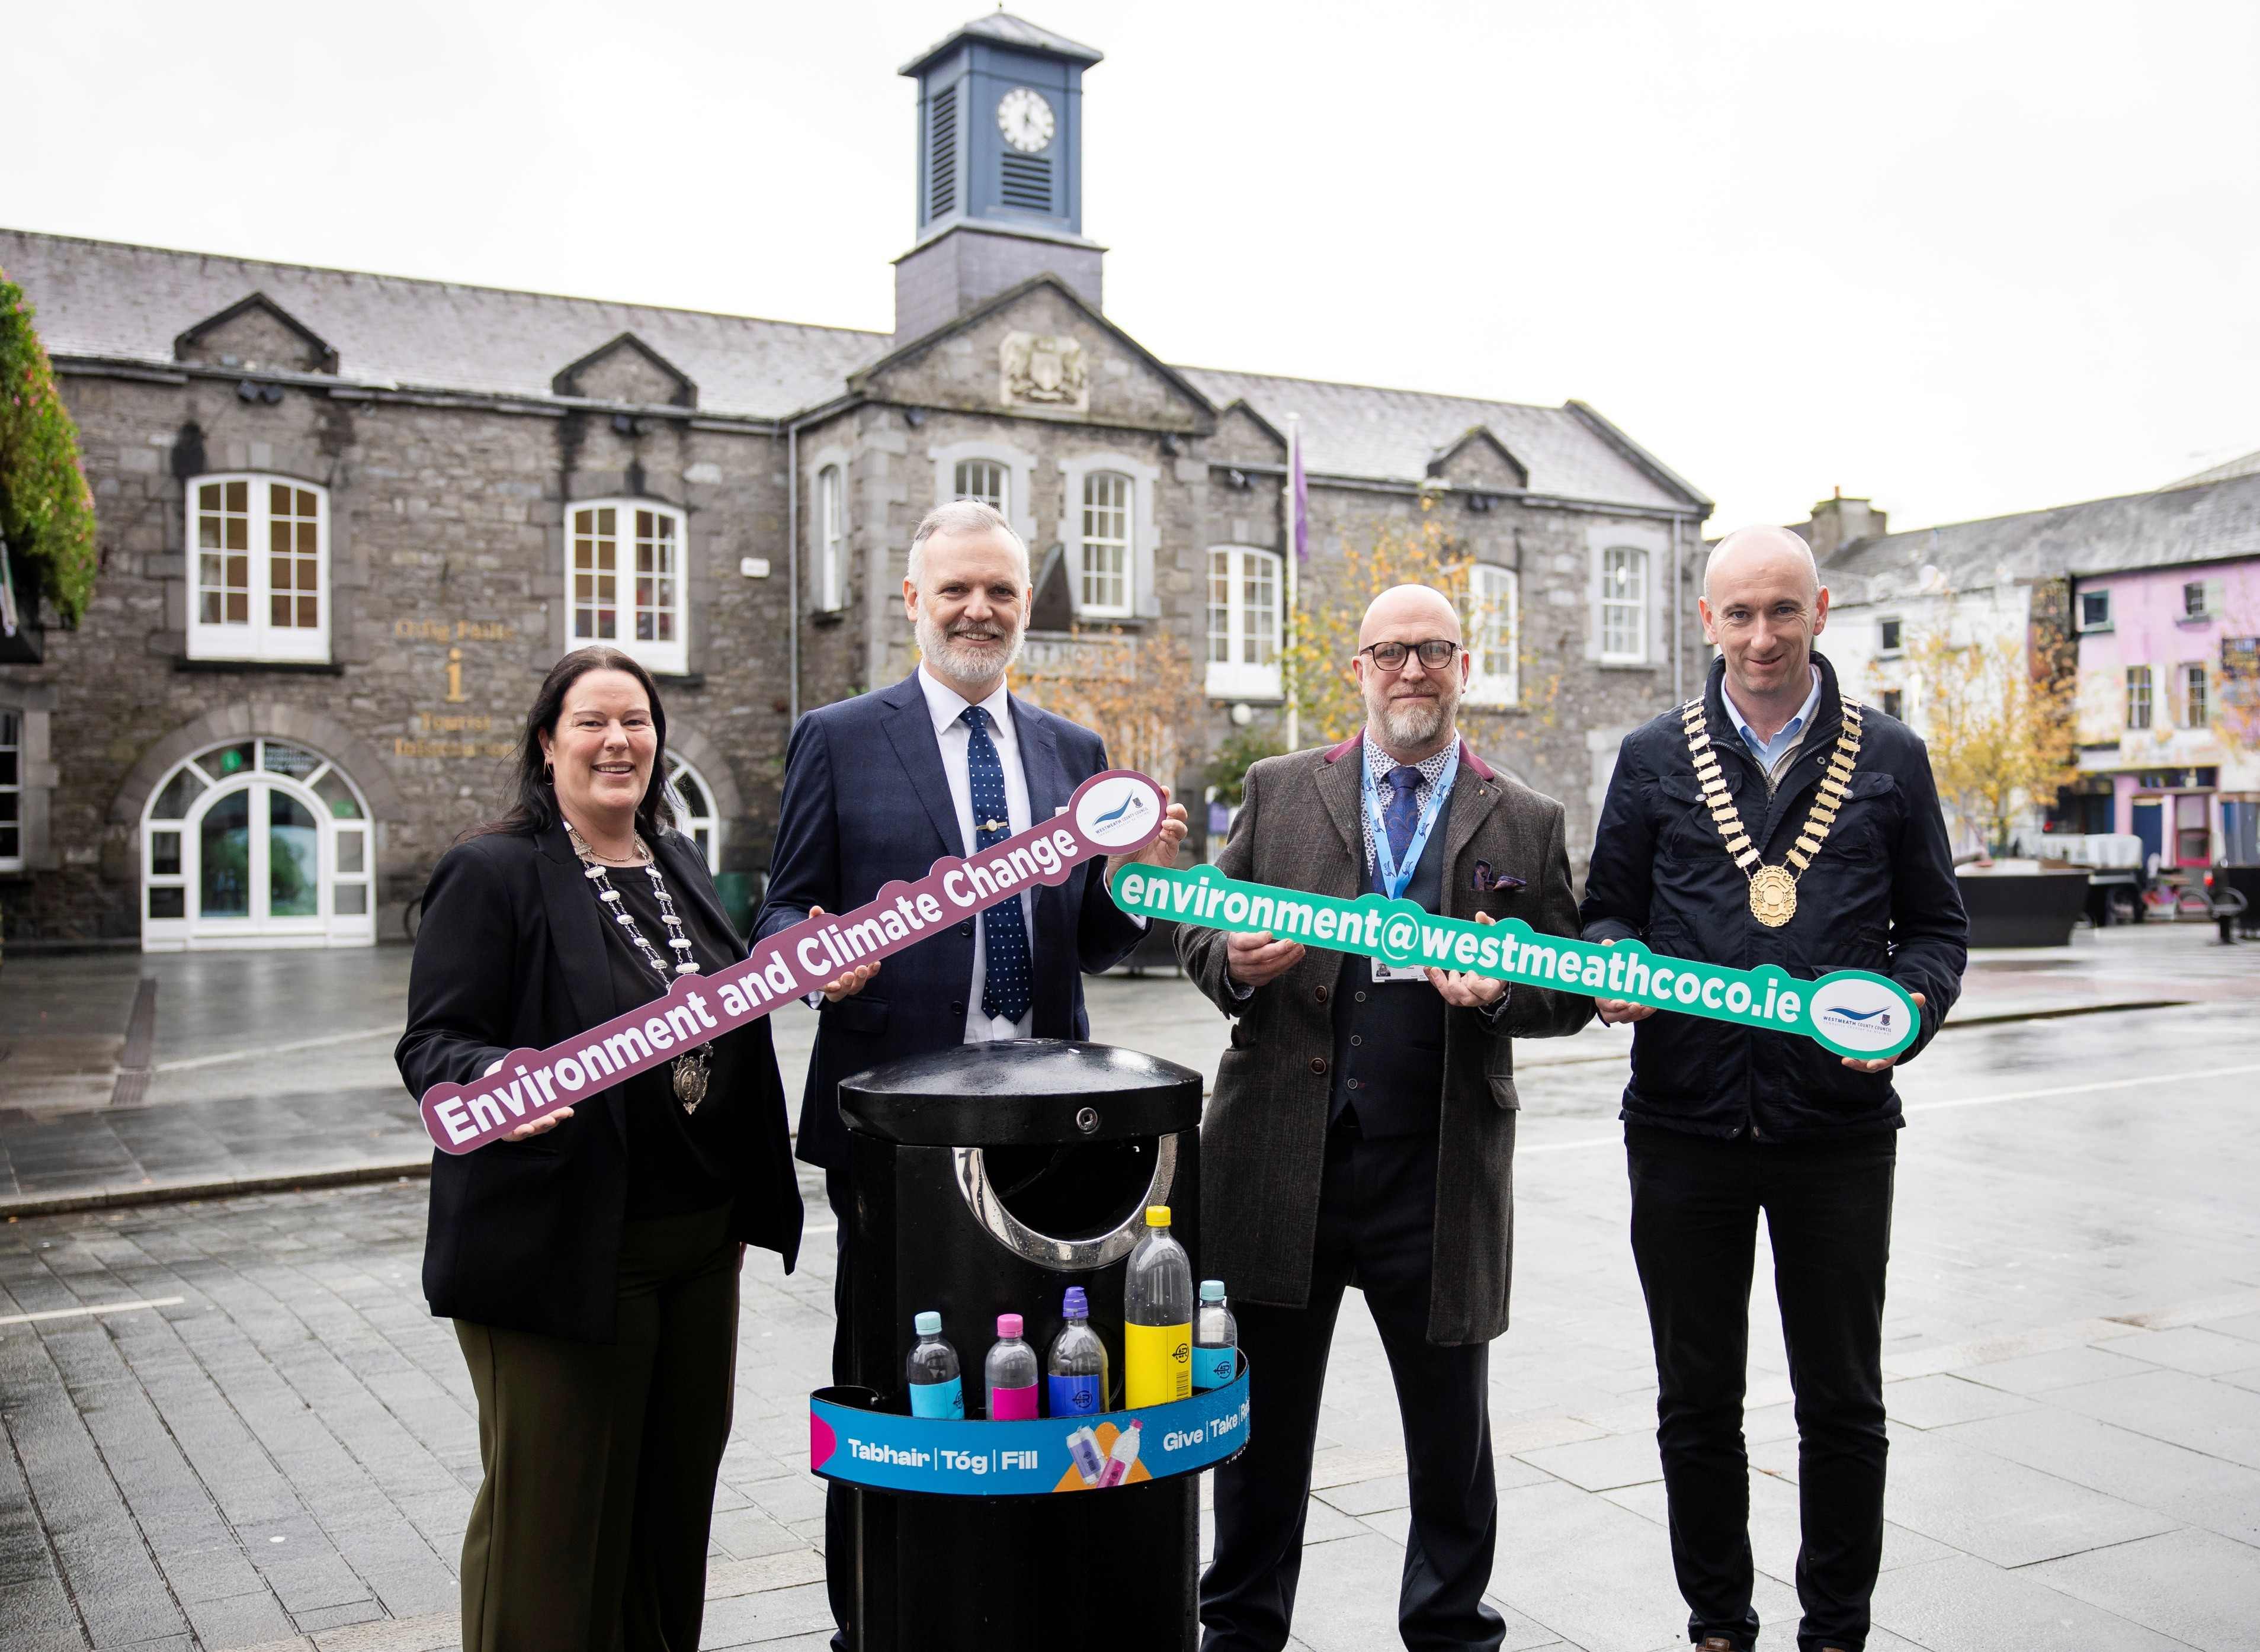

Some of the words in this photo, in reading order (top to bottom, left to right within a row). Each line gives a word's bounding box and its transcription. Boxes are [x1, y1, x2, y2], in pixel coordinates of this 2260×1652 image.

[1121, 874, 1800, 1022] environment@westmeathcoco.ie
[434, 992, 717, 1145] Environment
[717, 951, 798, 1016] and
[797, 894, 943, 976] Climate
[944, 830, 1078, 906] Change
[1823, 1015, 1856, 1026] WESTMEATH
[1163, 1429, 1203, 1451] Give
[1210, 1414, 1238, 1438] Take
[848, 1438, 930, 1467] Tabhair
[941, 1451, 988, 1474] Tóg
[1002, 1451, 1038, 1470] Fill
